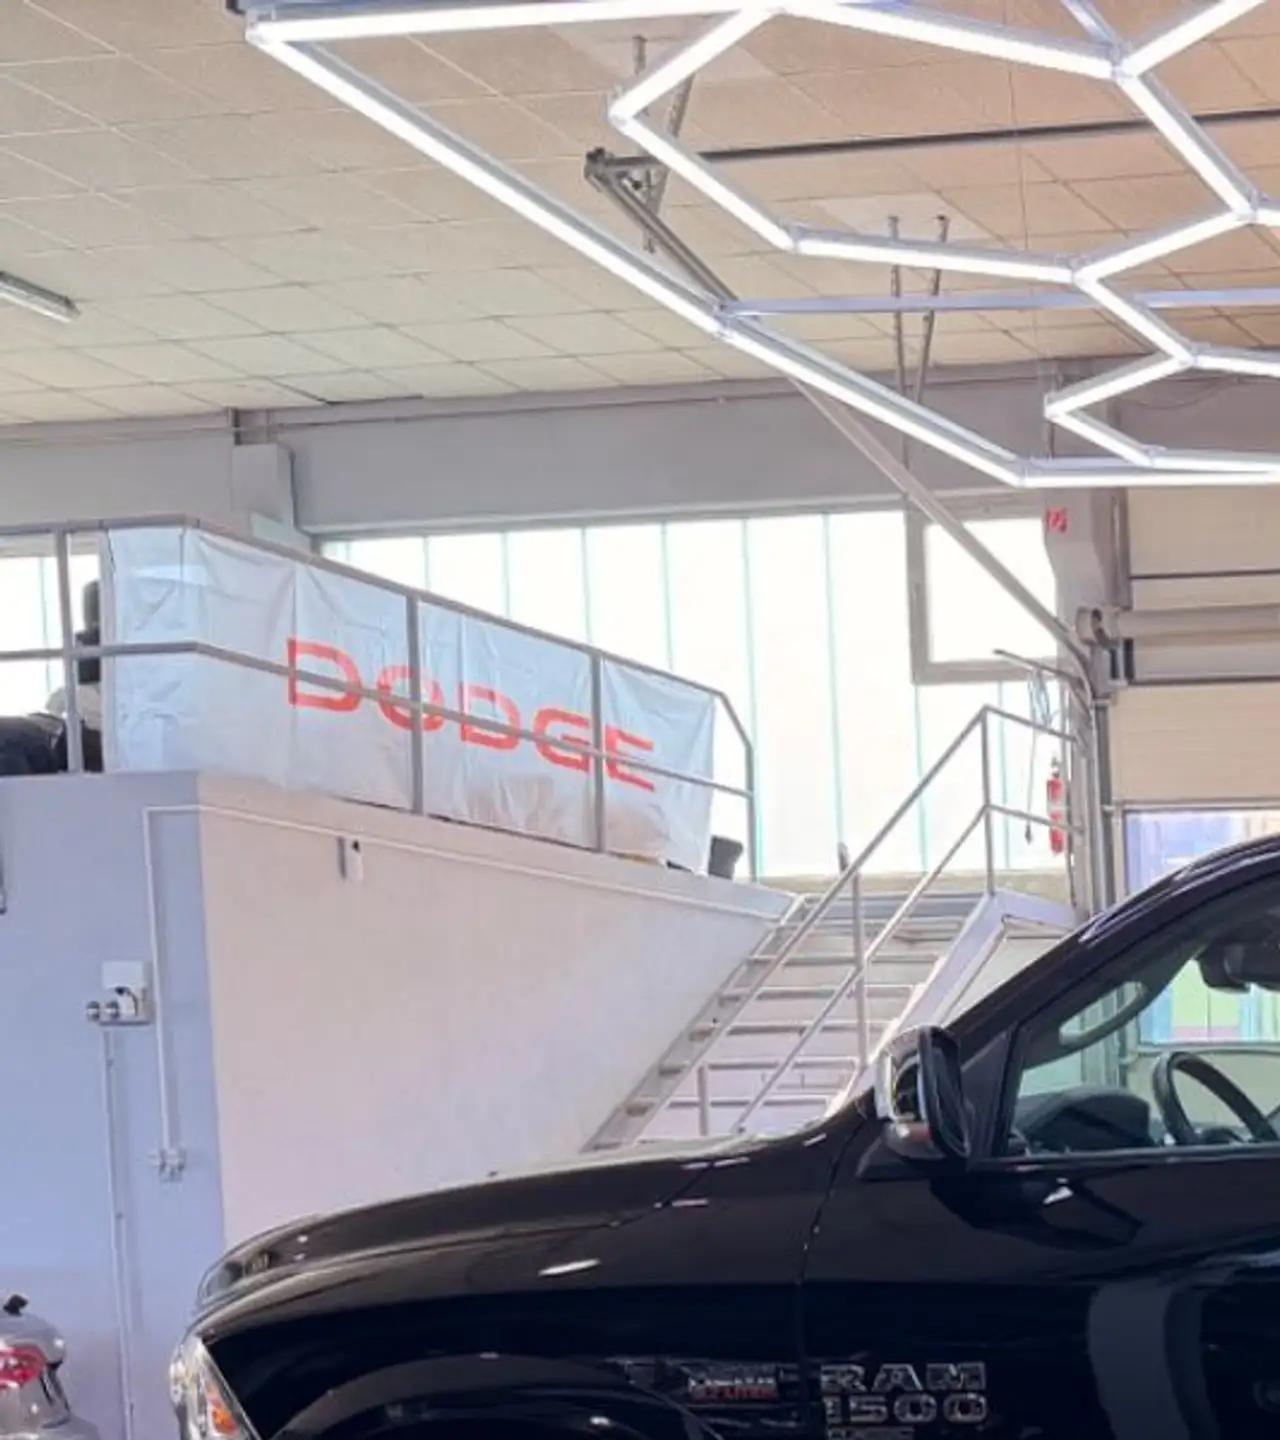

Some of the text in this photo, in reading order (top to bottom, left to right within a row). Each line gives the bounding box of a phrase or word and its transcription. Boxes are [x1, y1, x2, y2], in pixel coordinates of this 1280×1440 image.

[286, 638, 655, 792] DODGE
[820, 1361, 987, 1392] RAM
[823, 1393, 988, 1423] 1500
